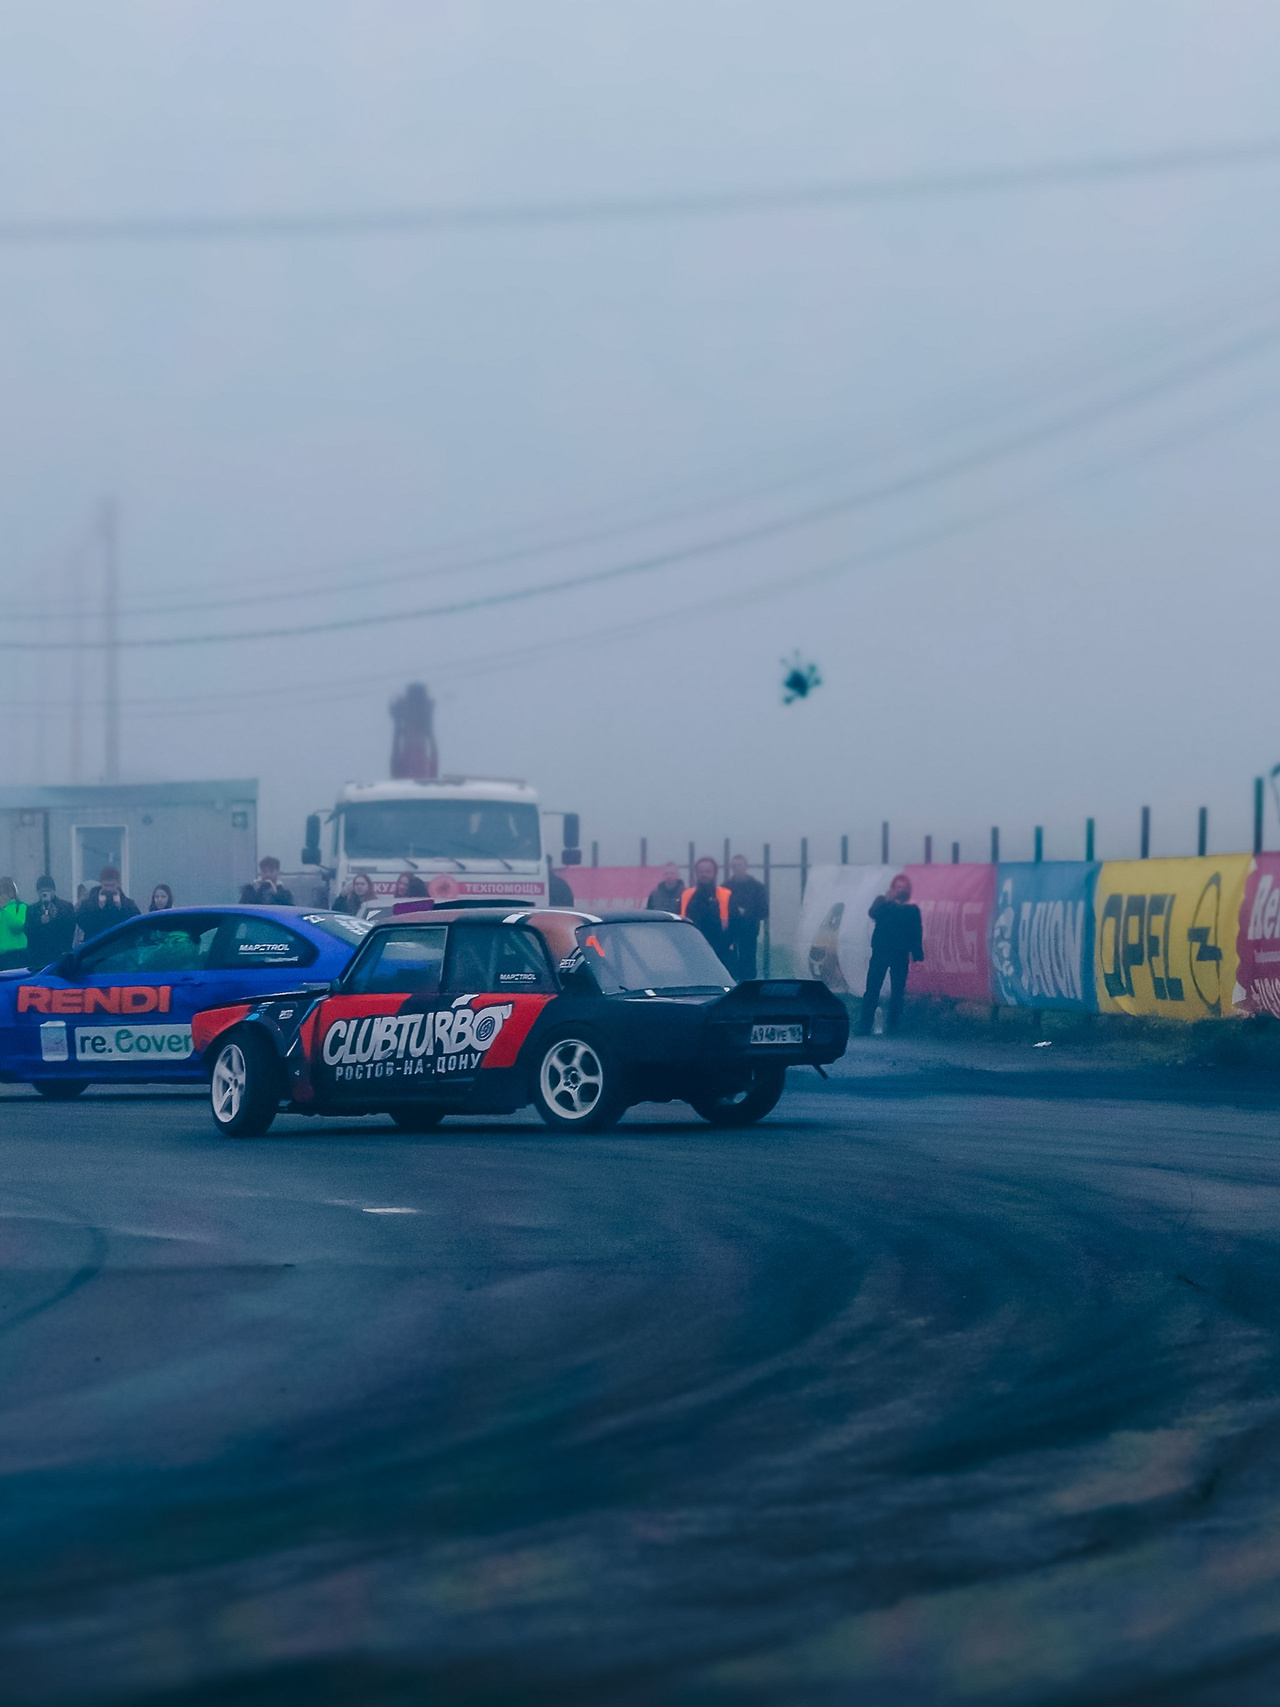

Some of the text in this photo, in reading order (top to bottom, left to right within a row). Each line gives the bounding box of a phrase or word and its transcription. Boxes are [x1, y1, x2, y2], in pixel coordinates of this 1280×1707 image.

[464, 883, 541, 894] ТЕХПОМОЩЬ
[238, 943, 290, 951] MAPETROL
[1101, 893, 1186, 1002] OPEL
[499, 973, 537, 981] MAPETROL
[17, 985, 172, 1014] RENDI
[322, 1001, 513, 1066] CLUBTURBO
